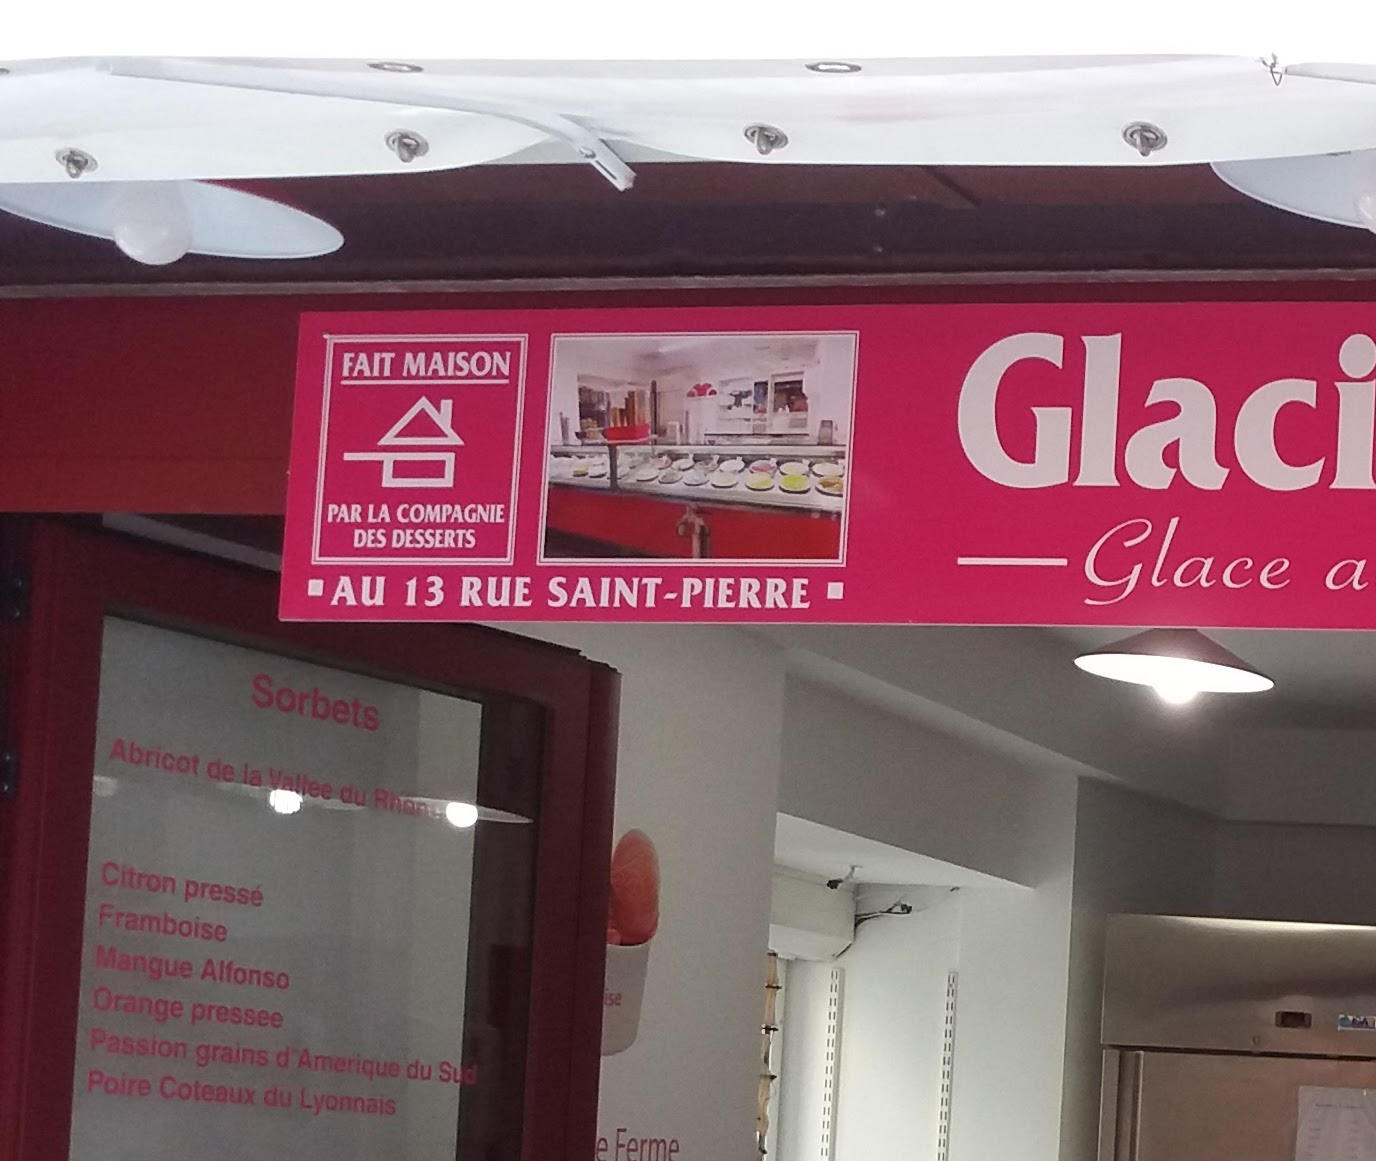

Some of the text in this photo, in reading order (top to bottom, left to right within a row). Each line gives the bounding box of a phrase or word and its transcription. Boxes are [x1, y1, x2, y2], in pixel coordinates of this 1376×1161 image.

[341, 350, 511, 378] FAIT MAISON
[328, 503, 506, 524] PAR LA COMPAGNIE
[353, 529, 477, 549] DES DESSERTS
[1081, 516, 1292, 597] Glace
[329, 575, 812, 610] AU 13 RUE SAINT-PIERRE
[250, 673, 381, 732] Sorbets
[109, 737, 200, 776] Abricot
[207, 756, 235, 783] de
[242, 763, 263, 789] la
[340, 781, 367, 807] du
[100, 861, 265, 908] Citron pressé
[98, 902, 228, 942] Framboise
[94, 944, 291, 990] Mangue Alfonso
[92, 986, 184, 1023] Orange
[88, 1028, 188, 1060] Passion
[196, 1039, 268, 1071] grains
[406, 1057, 433, 1083] du
[439, 1060, 478, 1085] Sud
[86, 1070, 397, 1117] Poire Coteaux du Lyonnais
